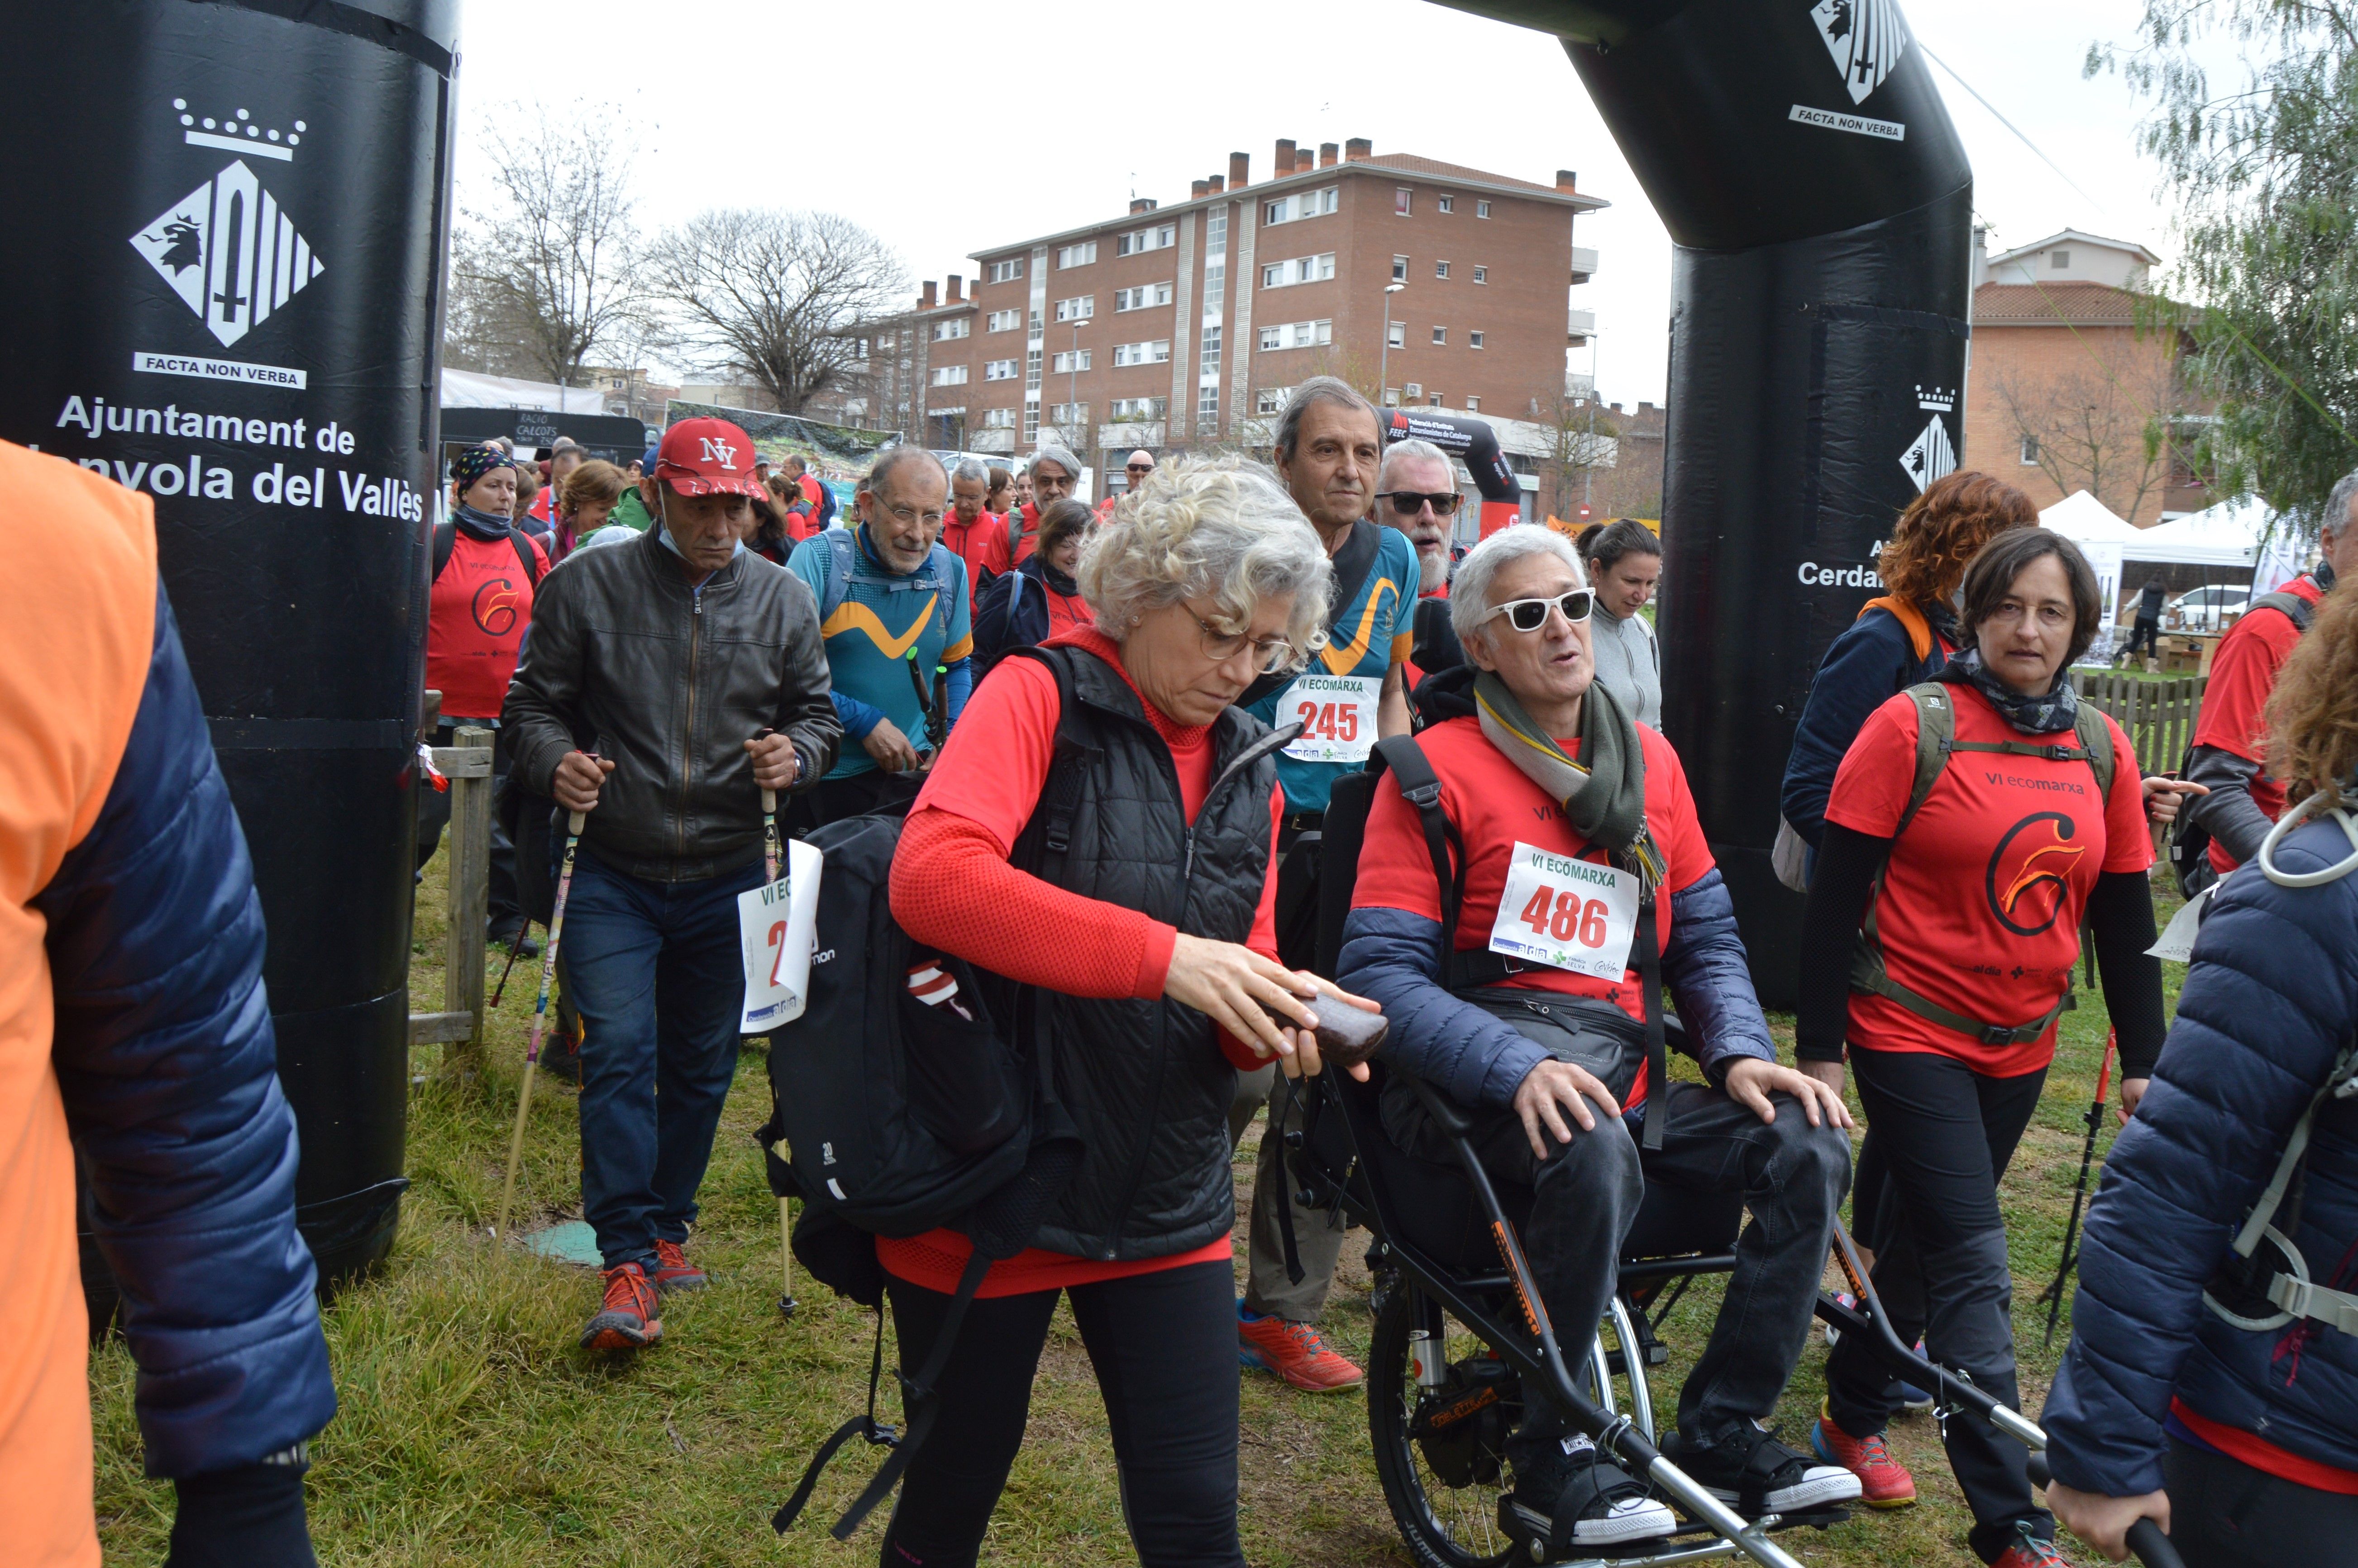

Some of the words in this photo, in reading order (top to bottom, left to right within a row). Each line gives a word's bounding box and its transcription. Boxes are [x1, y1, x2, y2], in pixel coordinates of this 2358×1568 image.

[1798, 110, 1834, 125] FACTA
[1838, 117, 1863, 130] NON
[1866, 123, 1899, 137] VERBA
[147, 357, 200, 374] FACTA
[205, 363, 242, 378] NON
[247, 368, 299, 386] VERBA
[56, 395, 307, 450] Ajuntament
[316, 421, 356, 455] de
[1389, 428, 1407, 438] FEEC
[699, 438, 737, 470] NY
[253, 462, 324, 509] del
[338, 470, 423, 523] Vallès
[1309, 679, 1363, 692] ECOMARXA
[1297, 701, 1358, 742] 245
[1986, 772, 2003, 785] VI
[2007, 776, 2085, 795] ecomarxa
[1533, 805, 1552, 821] VI
[1532, 853, 1544, 869] VI
[1547, 858, 1616, 888] ECOMARXA
[761, 887, 774, 906] VI
[1520, 885, 1609, 949] 486
[1494, 942, 1518, 952] Cerdanyola
[1567, 961, 1585, 970] SELVA
